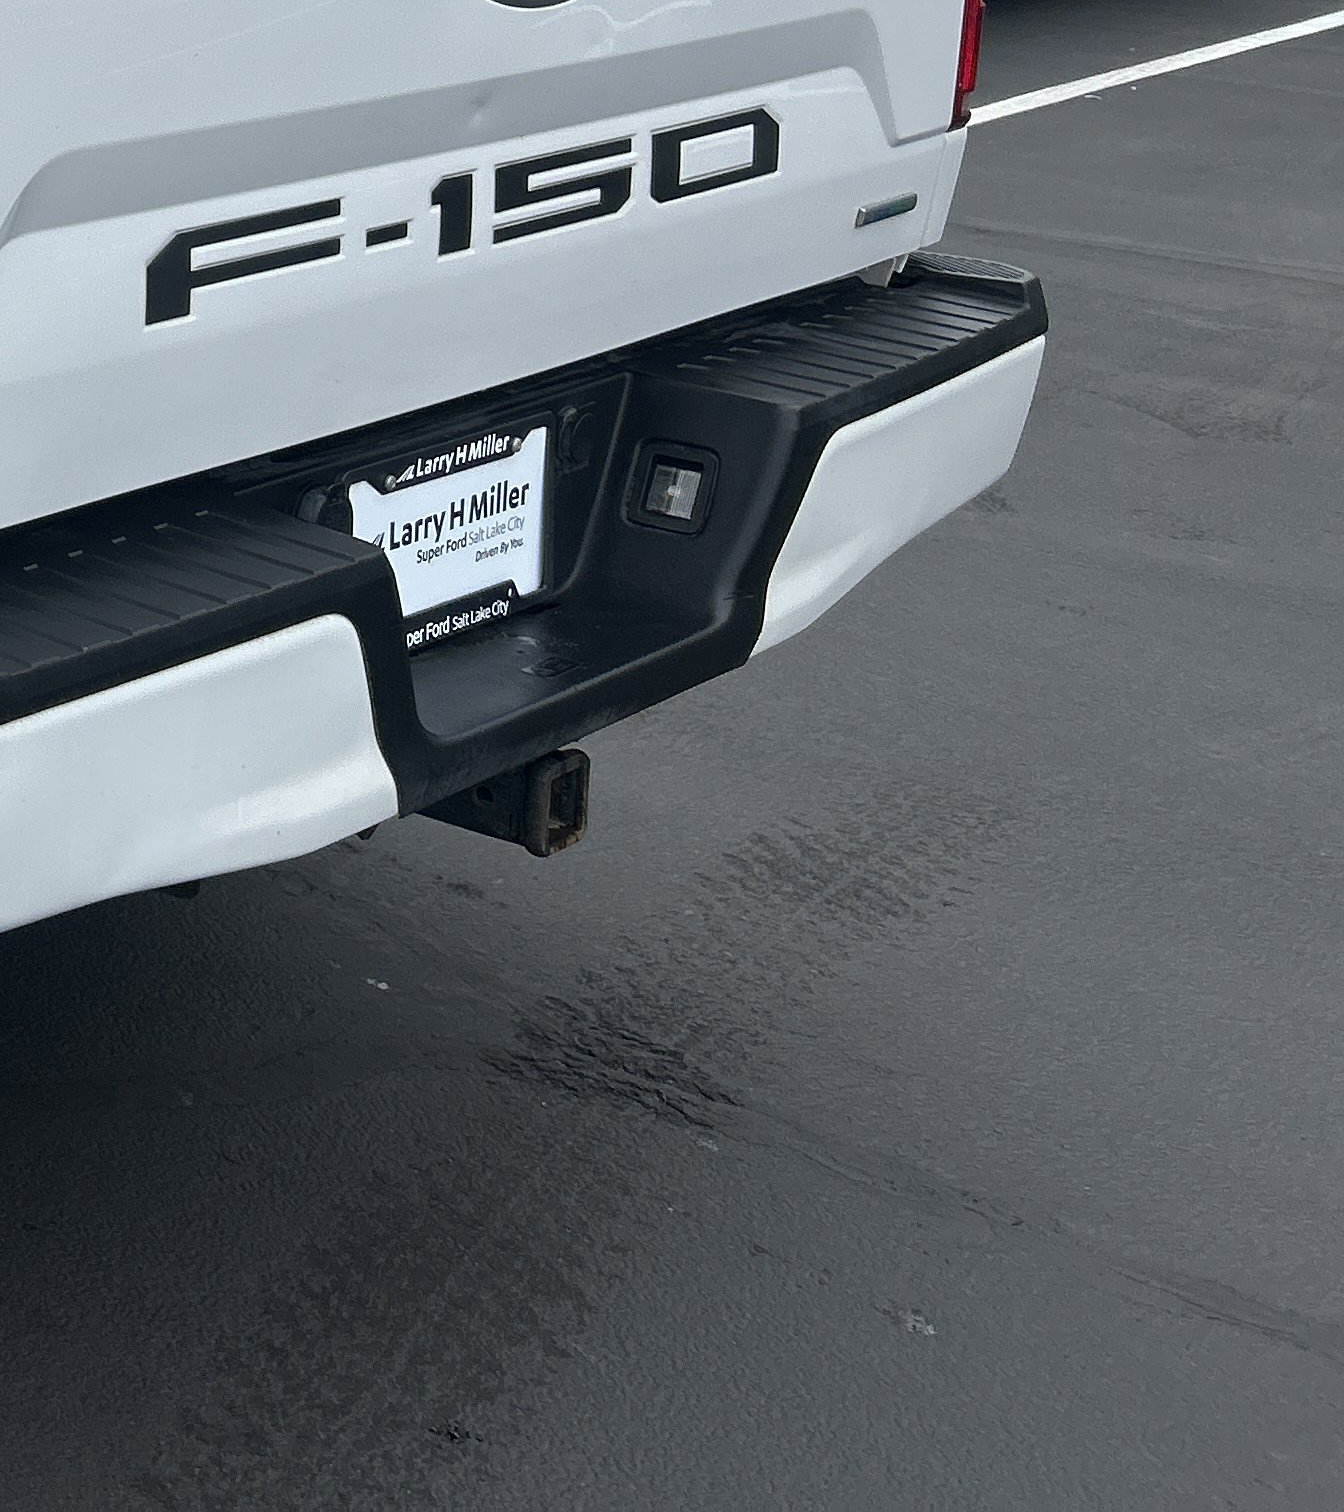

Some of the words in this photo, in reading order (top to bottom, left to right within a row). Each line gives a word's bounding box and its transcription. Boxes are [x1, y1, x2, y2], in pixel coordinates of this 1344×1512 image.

[144, 105, 781, 327] F-150
[415, 451, 454, 474] Larry
[455, 443, 468, 466] H
[467, 433, 511, 462] Miller
[389, 510, 446, 550] Larry
[449, 498, 465, 530] H
[468, 479, 530, 524] Miller
[416, 544, 444, 564] Super
[445, 531, 467, 553] Ford
[406, 628, 425, 649] per
[425, 615, 450, 641] Ford
[452, 612, 469, 631] Salt
[470, 606, 491, 624] Lake
